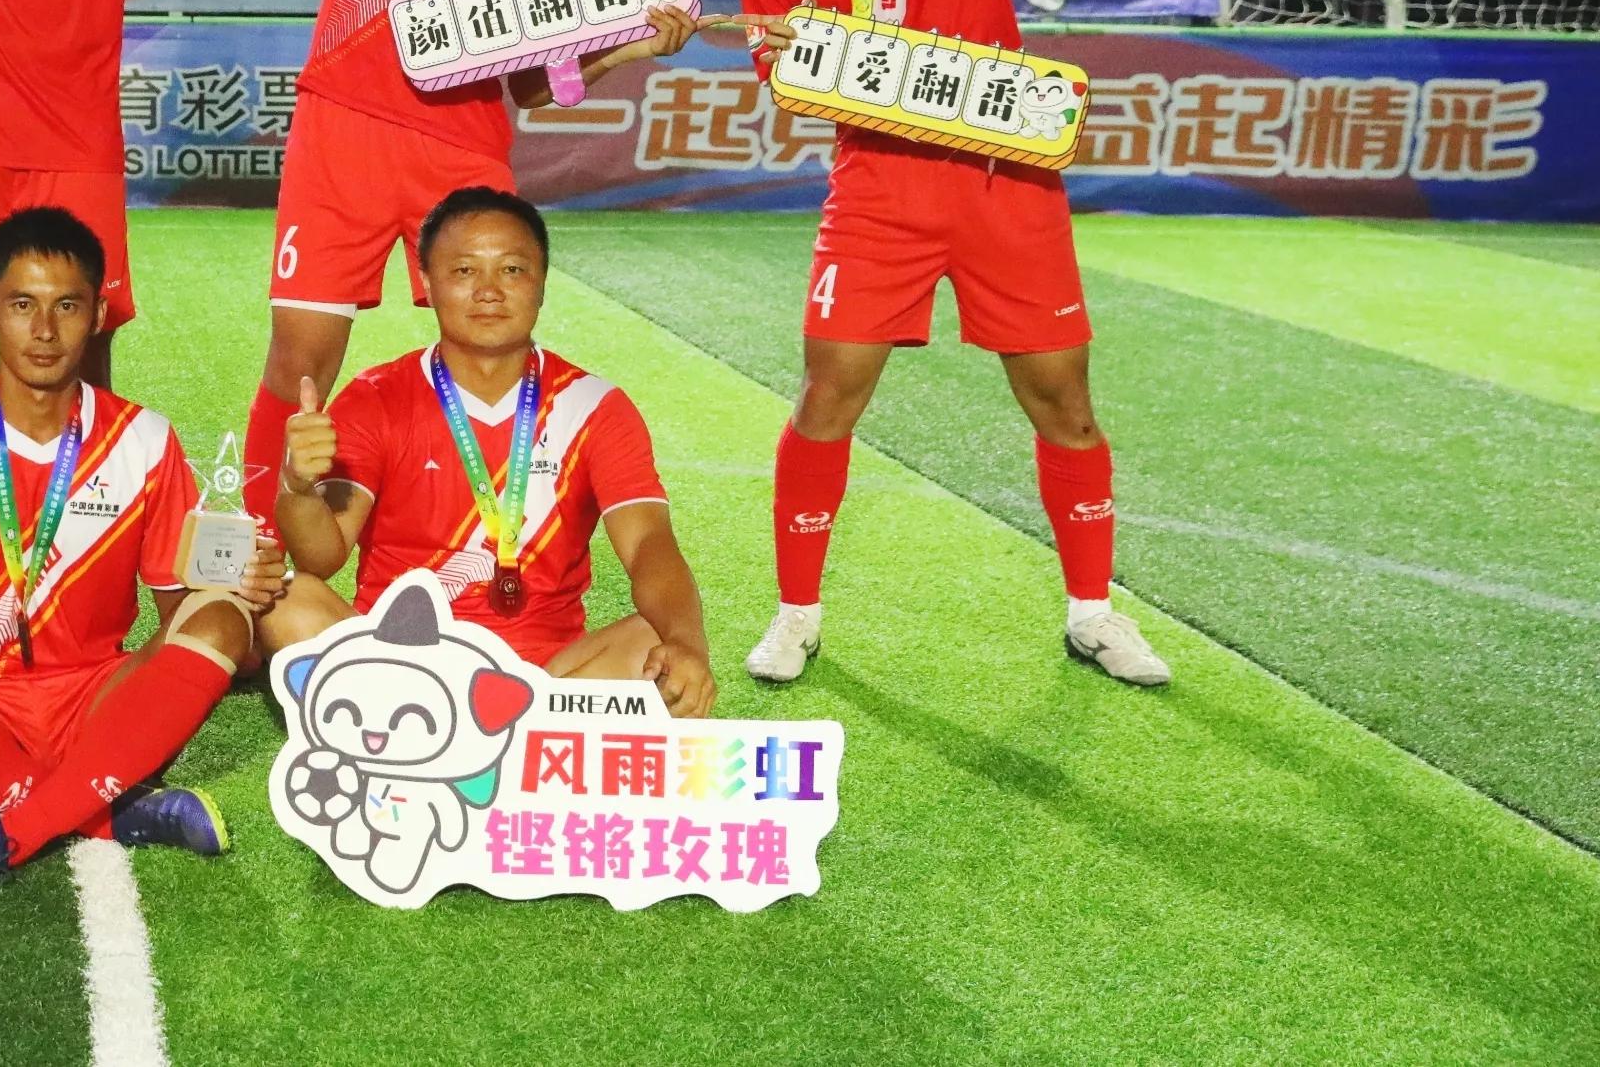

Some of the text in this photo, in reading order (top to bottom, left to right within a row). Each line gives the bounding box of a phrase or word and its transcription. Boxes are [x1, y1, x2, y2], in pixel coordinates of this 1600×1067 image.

[120, 68, 300, 132] 育彩票
[792, 37, 1018, 122] 可爱翻番
[1076, 74, 1547, 180] 益起精彩
[276, 225, 299, 280] 6
[811, 263, 839, 319] 4
[70, 501, 120, 513] 中国体育彩票
[548, 692, 648, 717] DREAM
[519, 729, 825, 803] 风雨彩虹
[484, 809, 790, 886] 铿锵玫瑰
